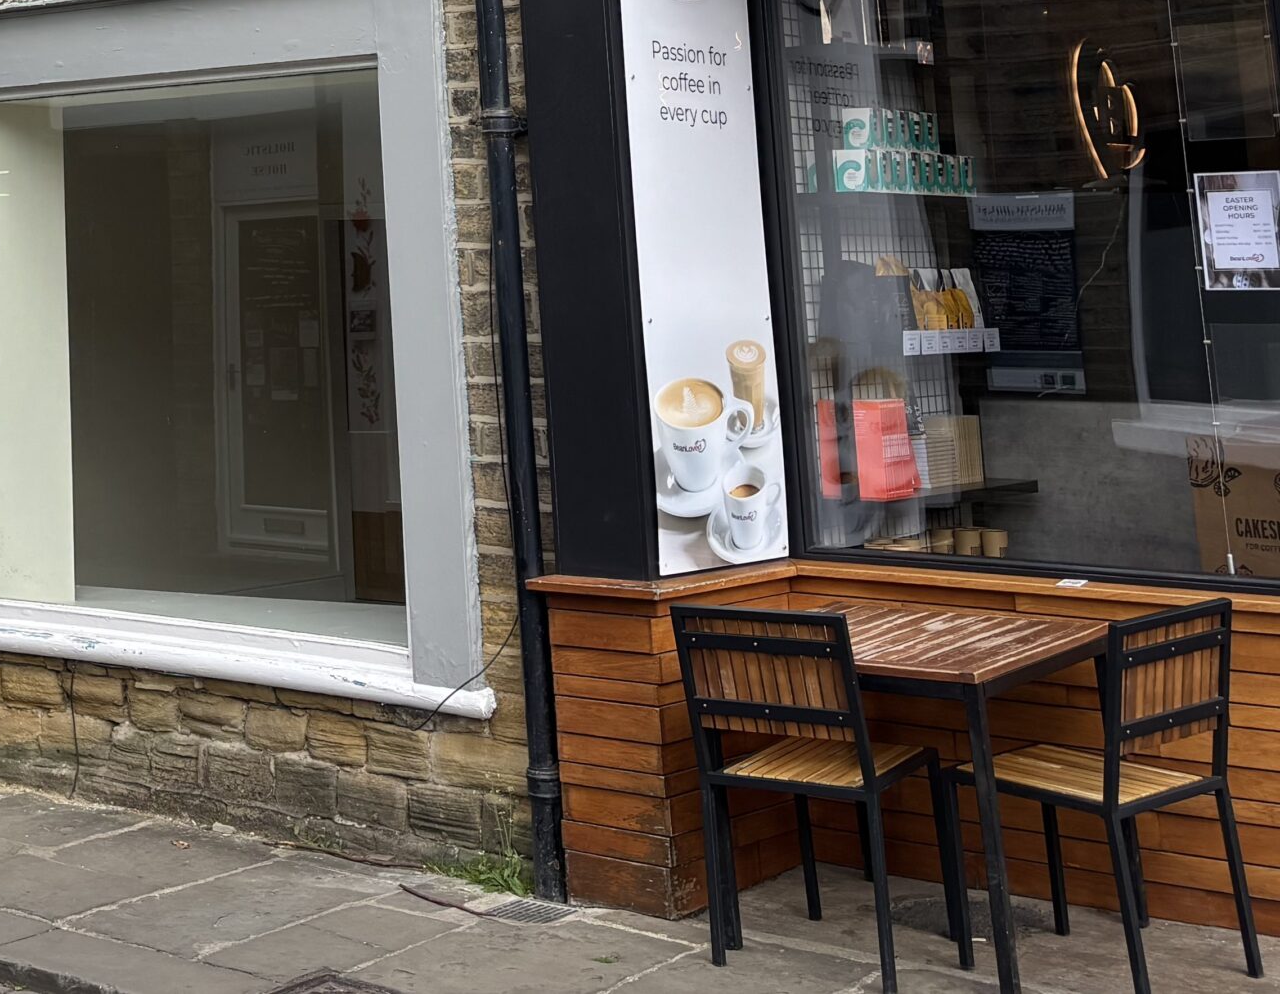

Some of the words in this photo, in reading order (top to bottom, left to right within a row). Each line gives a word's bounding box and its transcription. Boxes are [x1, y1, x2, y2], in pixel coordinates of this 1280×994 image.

[651, 40, 706, 65] Passion
[707, 45, 727, 66] for
[662, 72, 705, 94] coffee
[708, 74, 721, 95] in
[660, 105, 698, 127] every
[701, 108, 728, 129] cup
[1222, 204, 1258, 212] OPENING
[1225, 196, 1254, 204] EASTER
